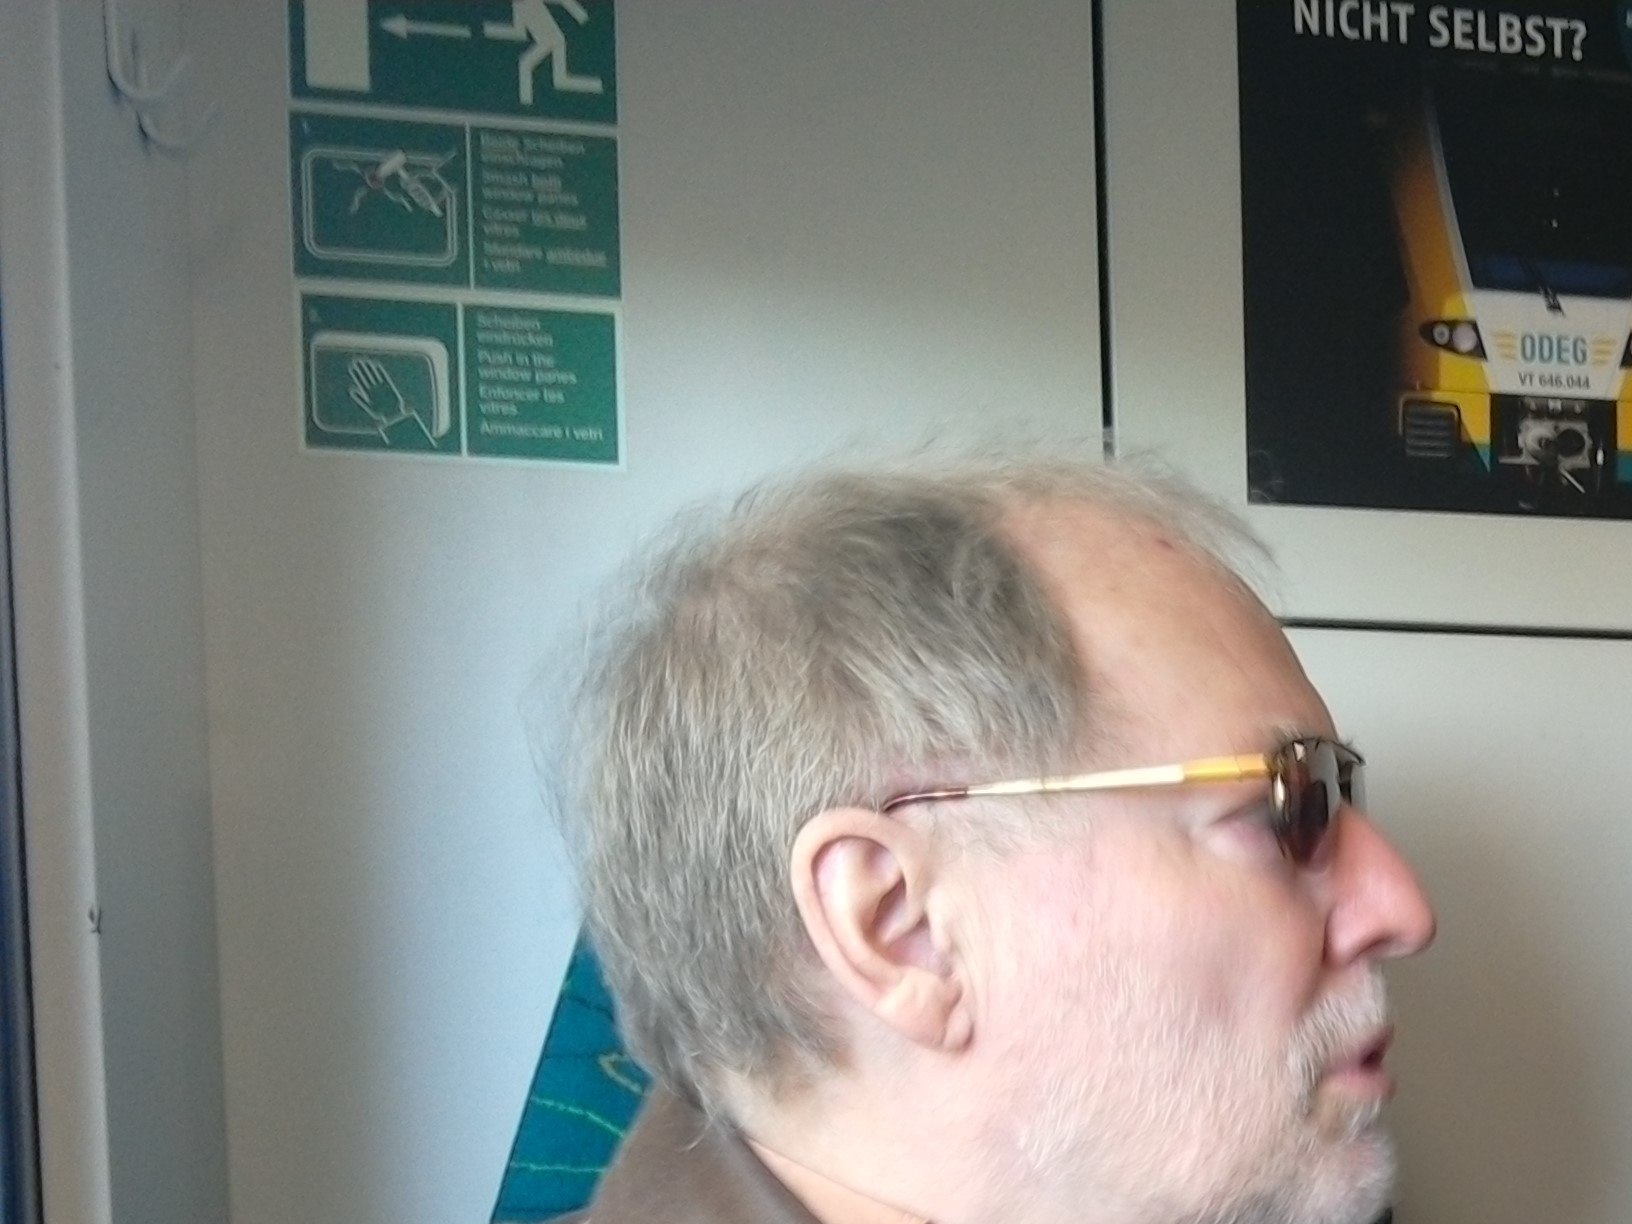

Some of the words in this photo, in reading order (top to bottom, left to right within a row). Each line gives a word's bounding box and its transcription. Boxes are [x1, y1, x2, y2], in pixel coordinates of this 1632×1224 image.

[1294, 0, 1415, 44] NICHT
[1429, 6, 1587, 62] SELBST?
[478, 315, 541, 331] Scheiben
[478, 350, 512, 366] Push
[516, 353, 530, 367] in
[533, 353, 554, 368] the
[1520, 334, 1588, 365] ODEG
[478, 366, 532, 382] window
[535, 370, 577, 386] panes
[1518, 371, 1534, 386] VT
[1538, 374, 1592, 390] 646.044
[479, 383, 540, 401] Enfoncer
[543, 387, 565, 403] les
[479, 401, 518, 416] vitres
[480, 419, 563, 438] Ammaccare
[573, 427, 603, 441] vetri
